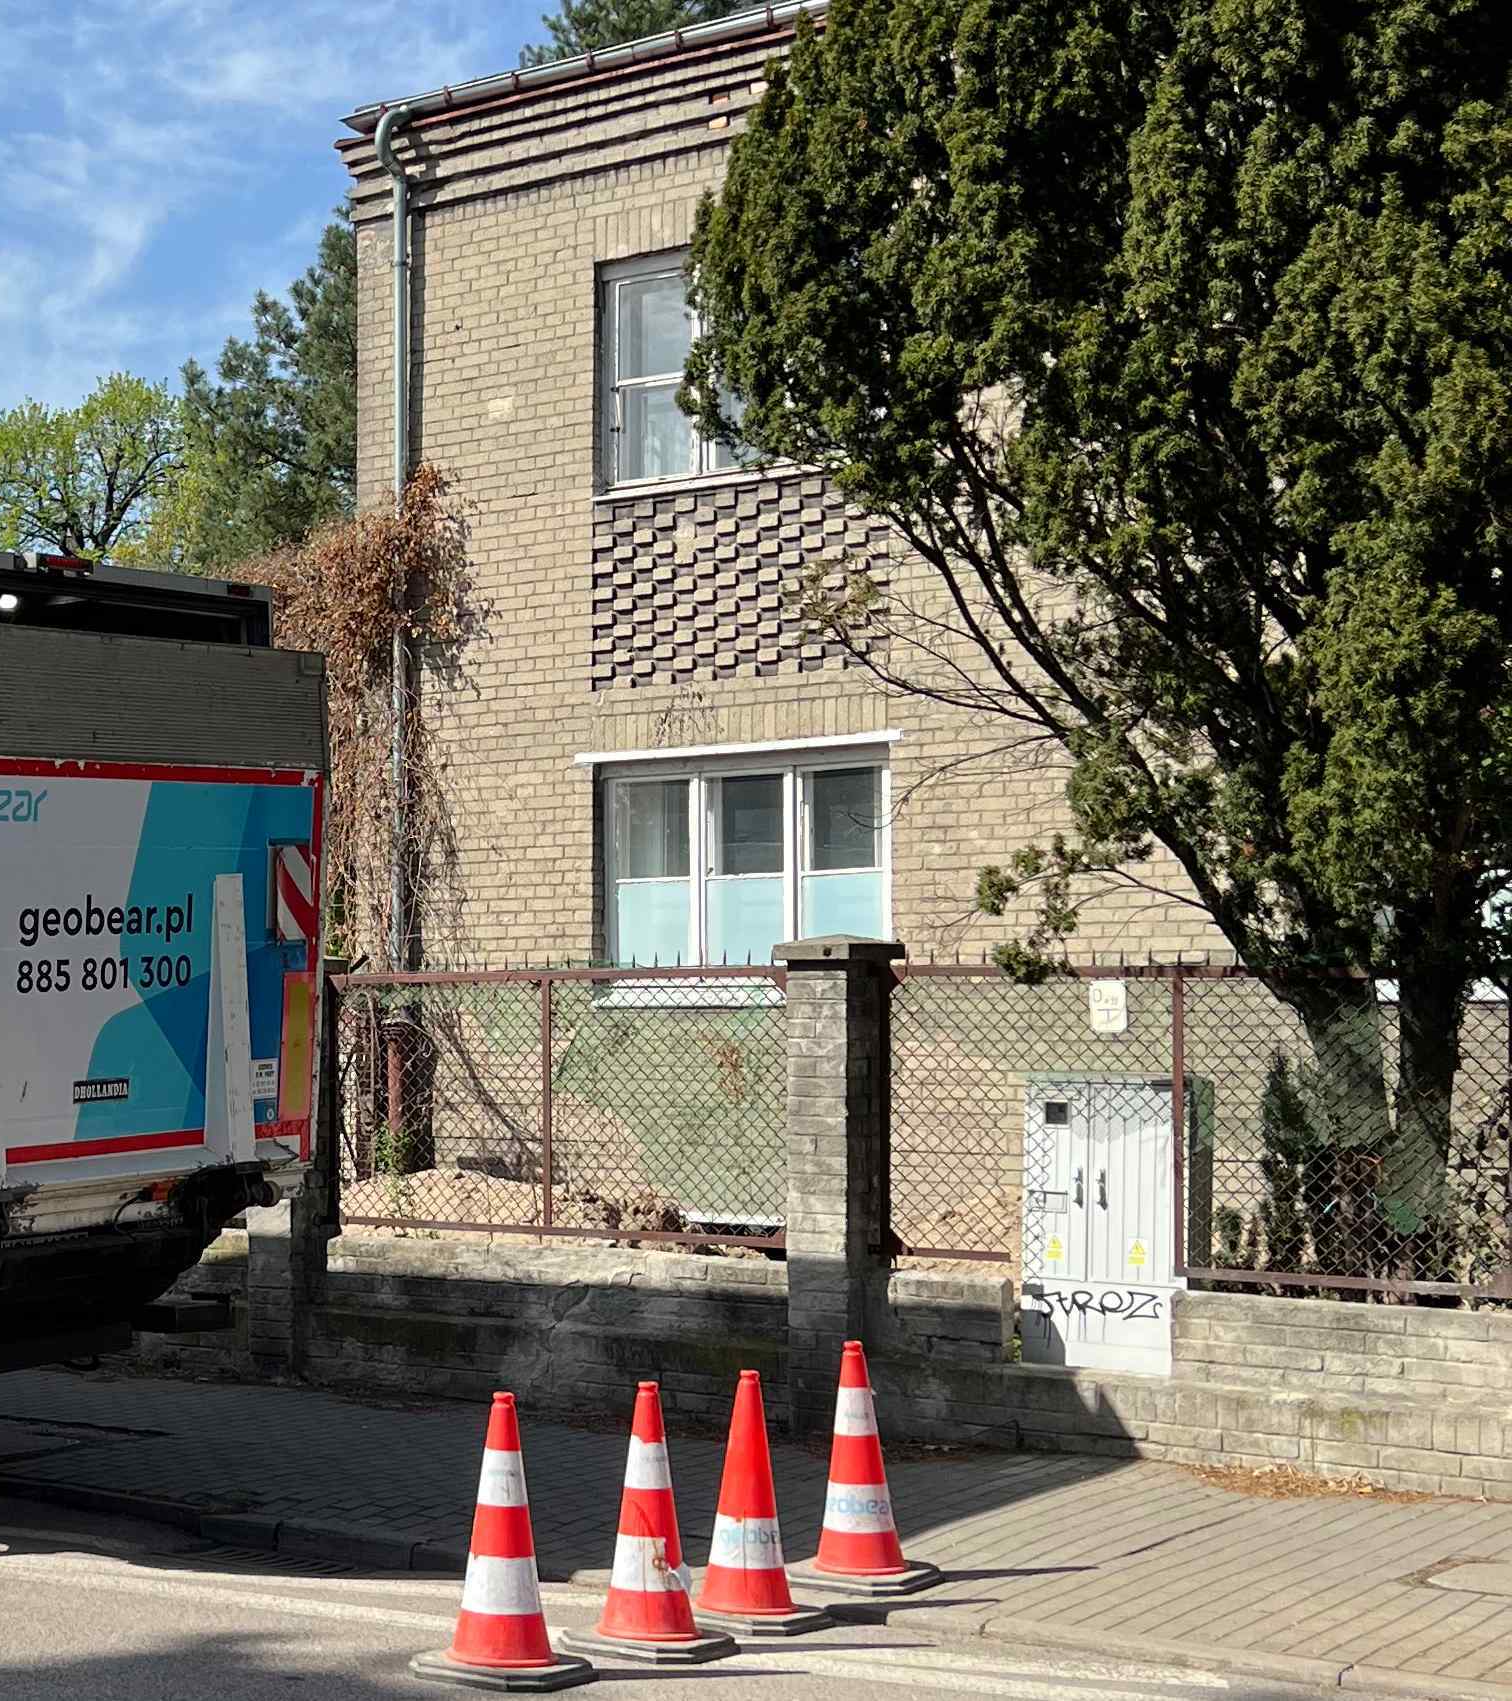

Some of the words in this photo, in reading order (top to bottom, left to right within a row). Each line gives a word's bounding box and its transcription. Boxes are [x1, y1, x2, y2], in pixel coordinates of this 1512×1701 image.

[19, 893, 193, 946] geobear.pl
[16, 959, 71, 994] 885
[81, 957, 129, 991] 801
[139, 955, 192, 988] 300
[74, 1082, 128, 1099] DHOLLANDIA
